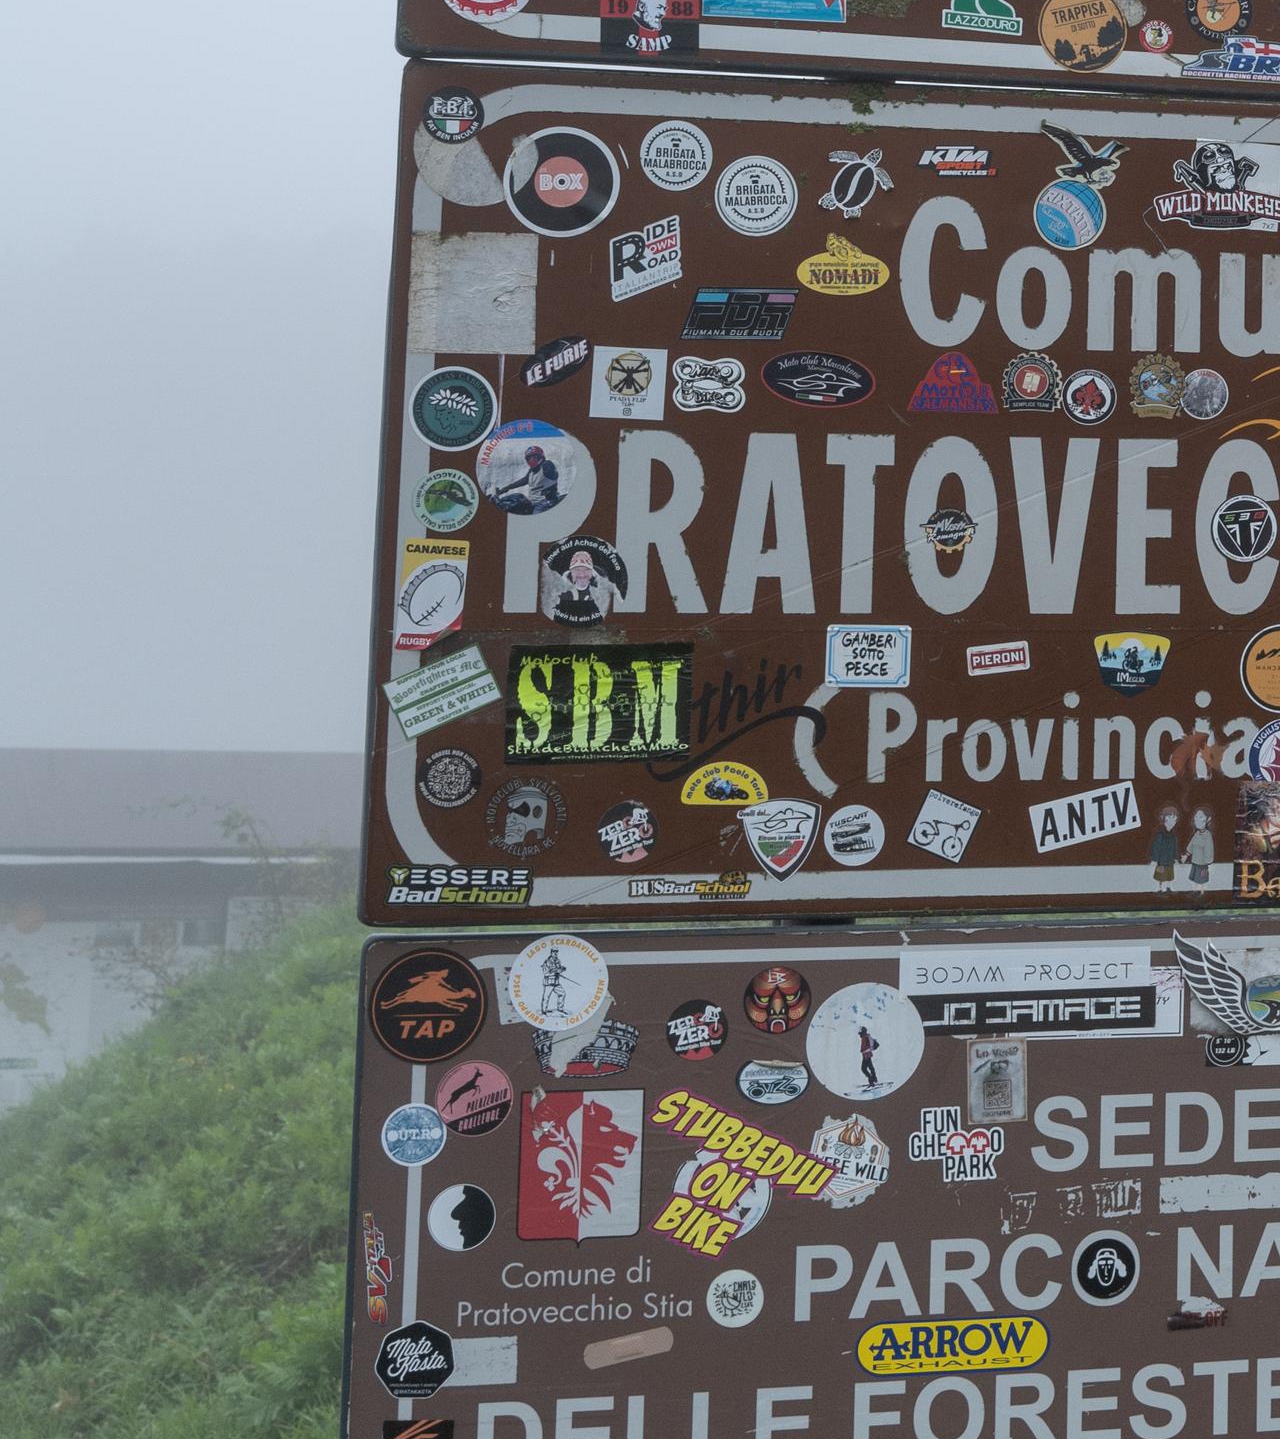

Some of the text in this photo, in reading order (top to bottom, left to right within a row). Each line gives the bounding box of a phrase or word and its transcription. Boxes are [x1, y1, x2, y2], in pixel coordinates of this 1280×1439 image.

[607, 0, 693, 16] 19 88
[1052, 3, 1108, 23] TRAPPISA
[947, 13, 1019, 32] LAZZODURO
[626, 33, 673, 53] SAMP
[655, 147, 696, 159] BRIGATA
[919, 149, 990, 166] KTM
[644, 157, 708, 172] MALABROCCA
[540, 172, 584, 192] BOX
[735, 184, 776, 196] BRIGATA
[725, 194, 788, 207] MALABROCCA
[1158, 191, 1203, 215] WILD
[809, 267, 880, 286] NOMADI
[683, 328, 785, 337] FIUMANA DUE RUOTE
[406, 544, 467, 557] CANAVESE
[399, 635, 433, 647] RUGBY
[841, 633, 898, 649] GAMBERI
[852, 646, 886, 661] SOTTO
[972, 650, 1025, 667] PIERONI
[845, 661, 890, 677] PESCE
[516, 660, 684, 749] SBM
[794, 683, 1260, 799] (Provincia
[1040, 786, 1139, 848] A.N.T.V.
[387, 886, 527, 905] BadSchool
[1023, 961, 1135, 983] PROJECT
[400, 1019, 456, 1039] TAP
[923, 1108, 960, 1133] FUN
[650, 1090, 834, 1196] STUBBEDUU
[854, 1160, 889, 1183] WILD
[944, 1155, 996, 1181] PARK
[691, 1161, 751, 1210] ON
[653, 1195, 741, 1257] BIKE
[502, 1255, 651, 1288] Comune di
[794, 1229, 1141, 1322] PARCO
[457, 1293, 693, 1327] Pratovecchio Stia
[868, 1320, 1035, 1362] ARROW
[872, 1354, 1035, 1373] EXHAUST
